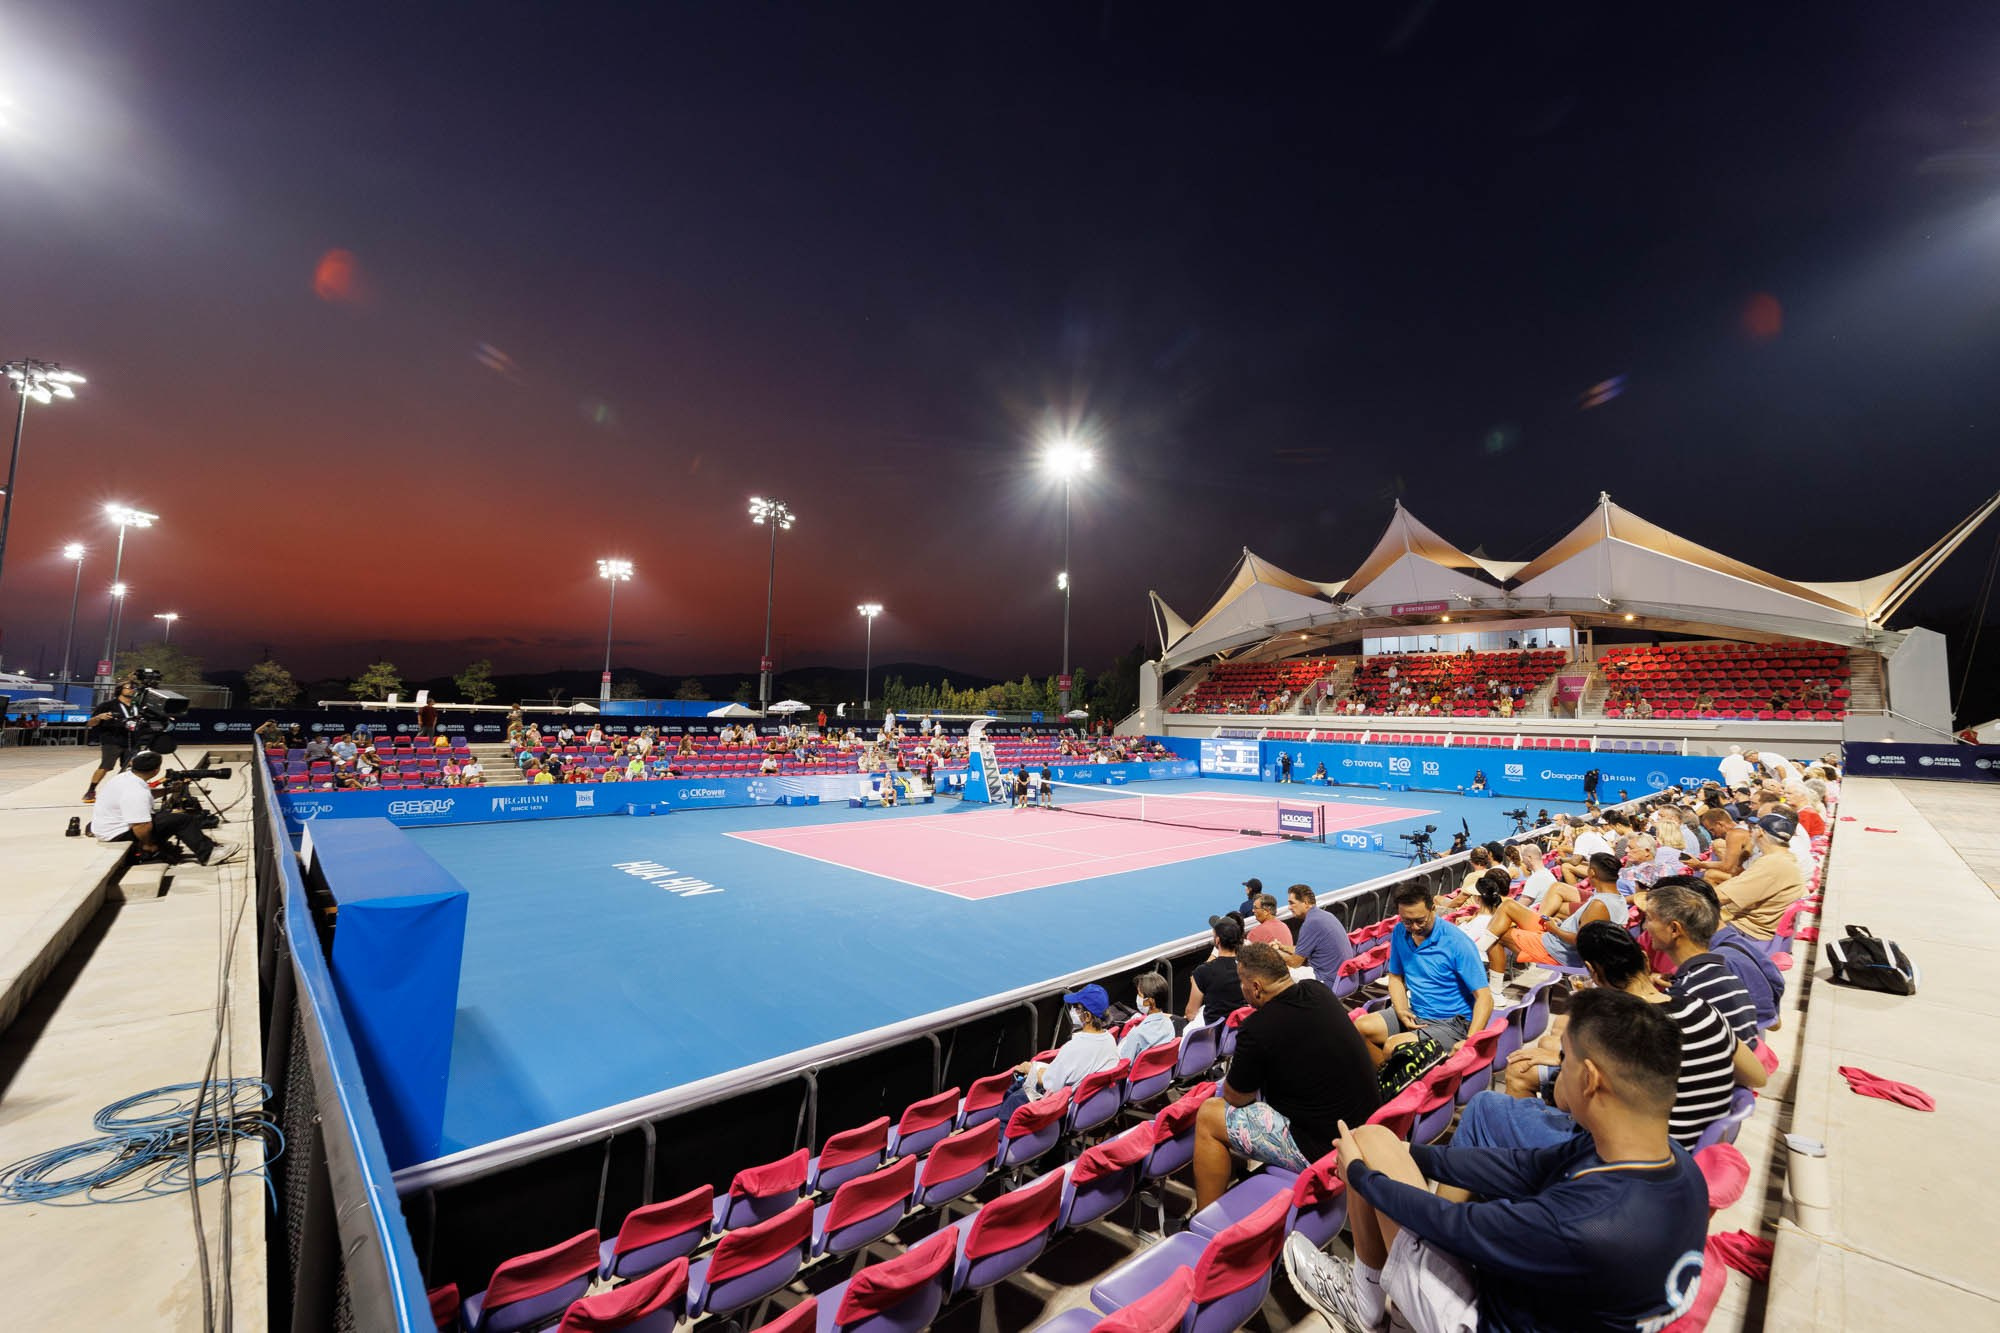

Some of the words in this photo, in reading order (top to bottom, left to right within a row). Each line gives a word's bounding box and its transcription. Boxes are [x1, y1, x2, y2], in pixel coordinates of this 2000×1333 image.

[1354, 760, 1383, 768] TOYOTA
[1422, 761, 1440, 771] 100
[689, 787, 727, 797] CKPower
[1281, 813, 1312, 823] HOLOGIC
[1341, 834, 1367, 848] apg
[611, 860, 680, 881] HUA
[650, 876, 725, 897] HIN
